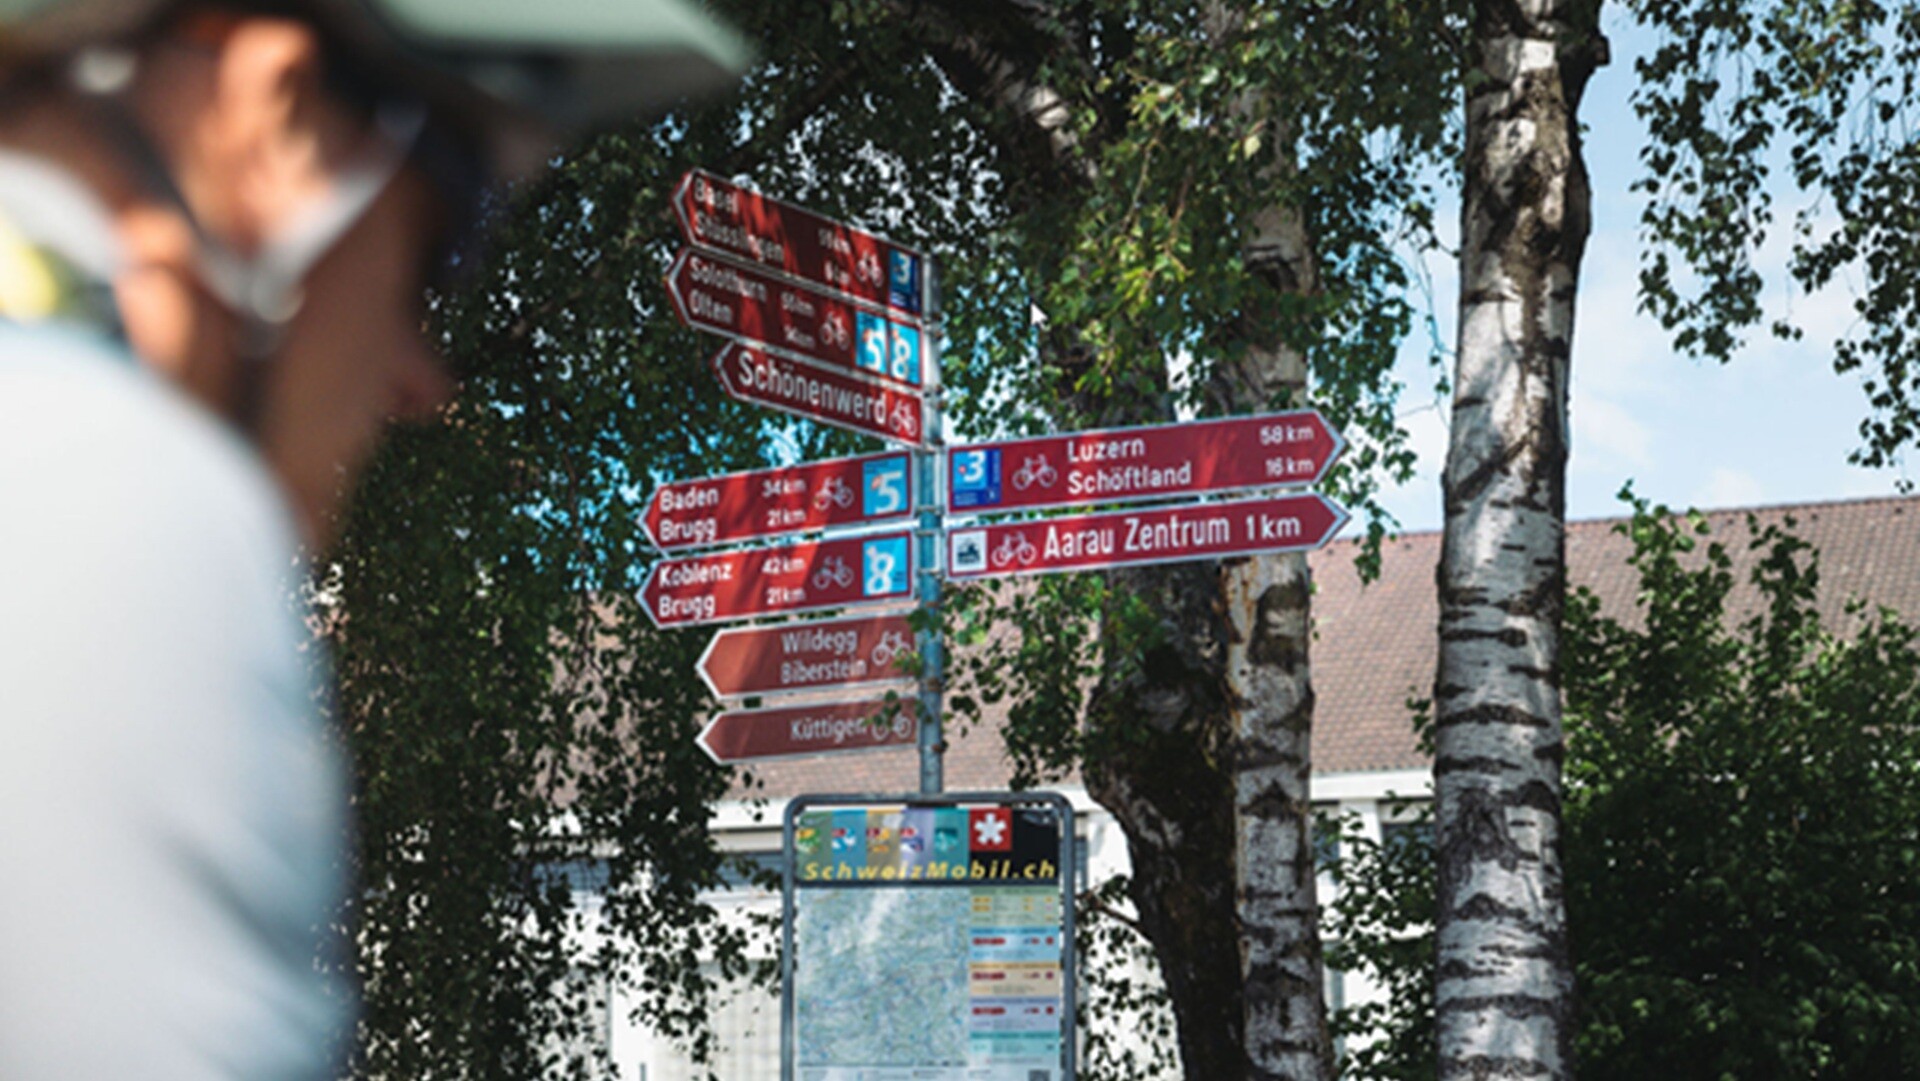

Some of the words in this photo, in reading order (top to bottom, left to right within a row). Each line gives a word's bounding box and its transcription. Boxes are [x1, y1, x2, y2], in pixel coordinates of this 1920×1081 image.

[694, 178, 739, 214] Basel
[897, 252, 912, 285] 3
[689, 289, 733, 324] Olten
[690, 256, 767, 302] Solothurn
[865, 328, 885, 372] 5
[891, 336, 911, 380] 8
[738, 350, 887, 425] Schönenwerd
[963, 450, 985, 482] 3
[1068, 437, 1145, 463] Luzern
[1260, 424, 1283, 446] 58
[1286, 423, 1315, 442] km
[659, 487, 719, 512] Baden
[874, 470, 903, 514] 5
[1067, 462, 1191, 495] Schöftland
[1265, 456, 1283, 477] 16
[1286, 456, 1315, 474] km
[659, 518, 717, 542] Brugg
[1044, 525, 1114, 560] Aarau
[1124, 516, 1230, 552] Zentrum
[1246, 516, 1256, 540] 1
[1261, 514, 1301, 538] km
[658, 561, 734, 588] Koblenz
[866, 552, 894, 595] 8
[658, 594, 716, 619] Brugg
[781, 629, 858, 654] Wildegg
[781, 656, 867, 684] Biberstein
[790, 715, 867, 744] Küttigen
[804, 859, 1055, 881] SchweizMobil.ch
